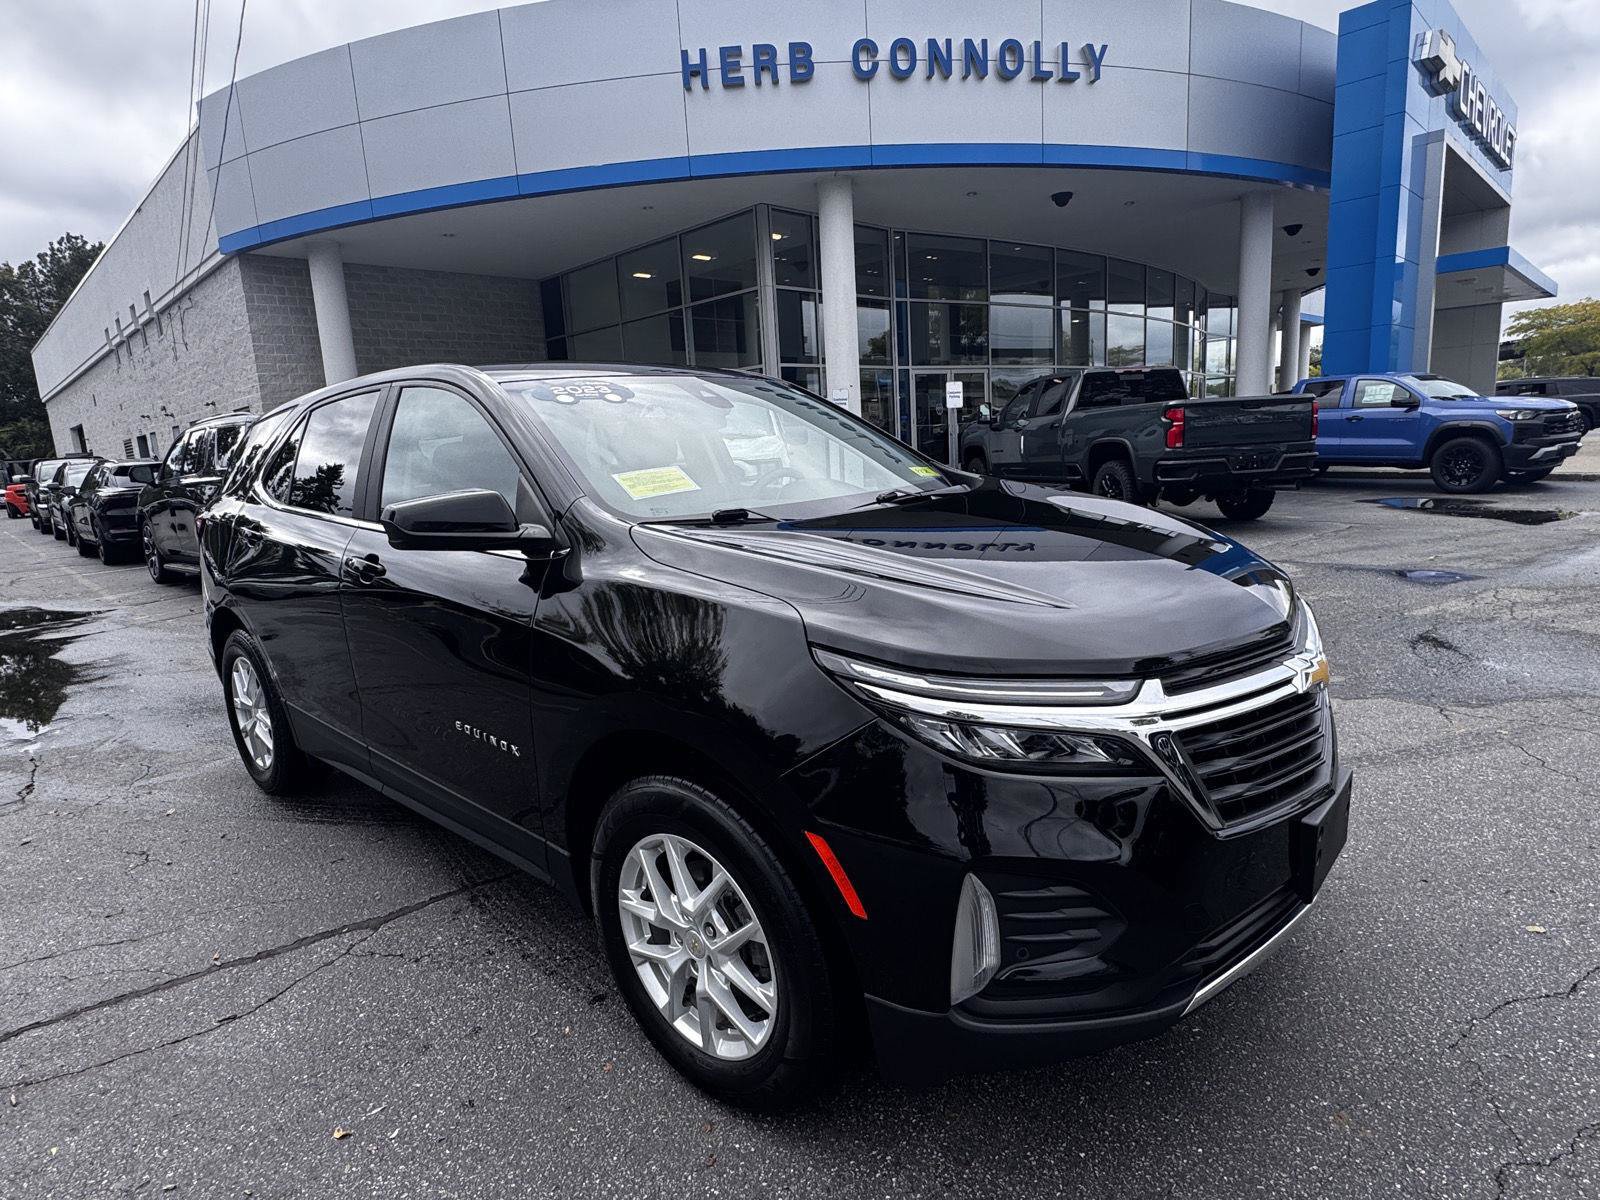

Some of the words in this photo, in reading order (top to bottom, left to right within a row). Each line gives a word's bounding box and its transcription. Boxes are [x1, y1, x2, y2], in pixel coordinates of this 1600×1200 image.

[680, 41, 815, 91] HERB
[851, 37, 1109, 85] CONNOLLY
[455, 720, 520, 757] EQUINOX
